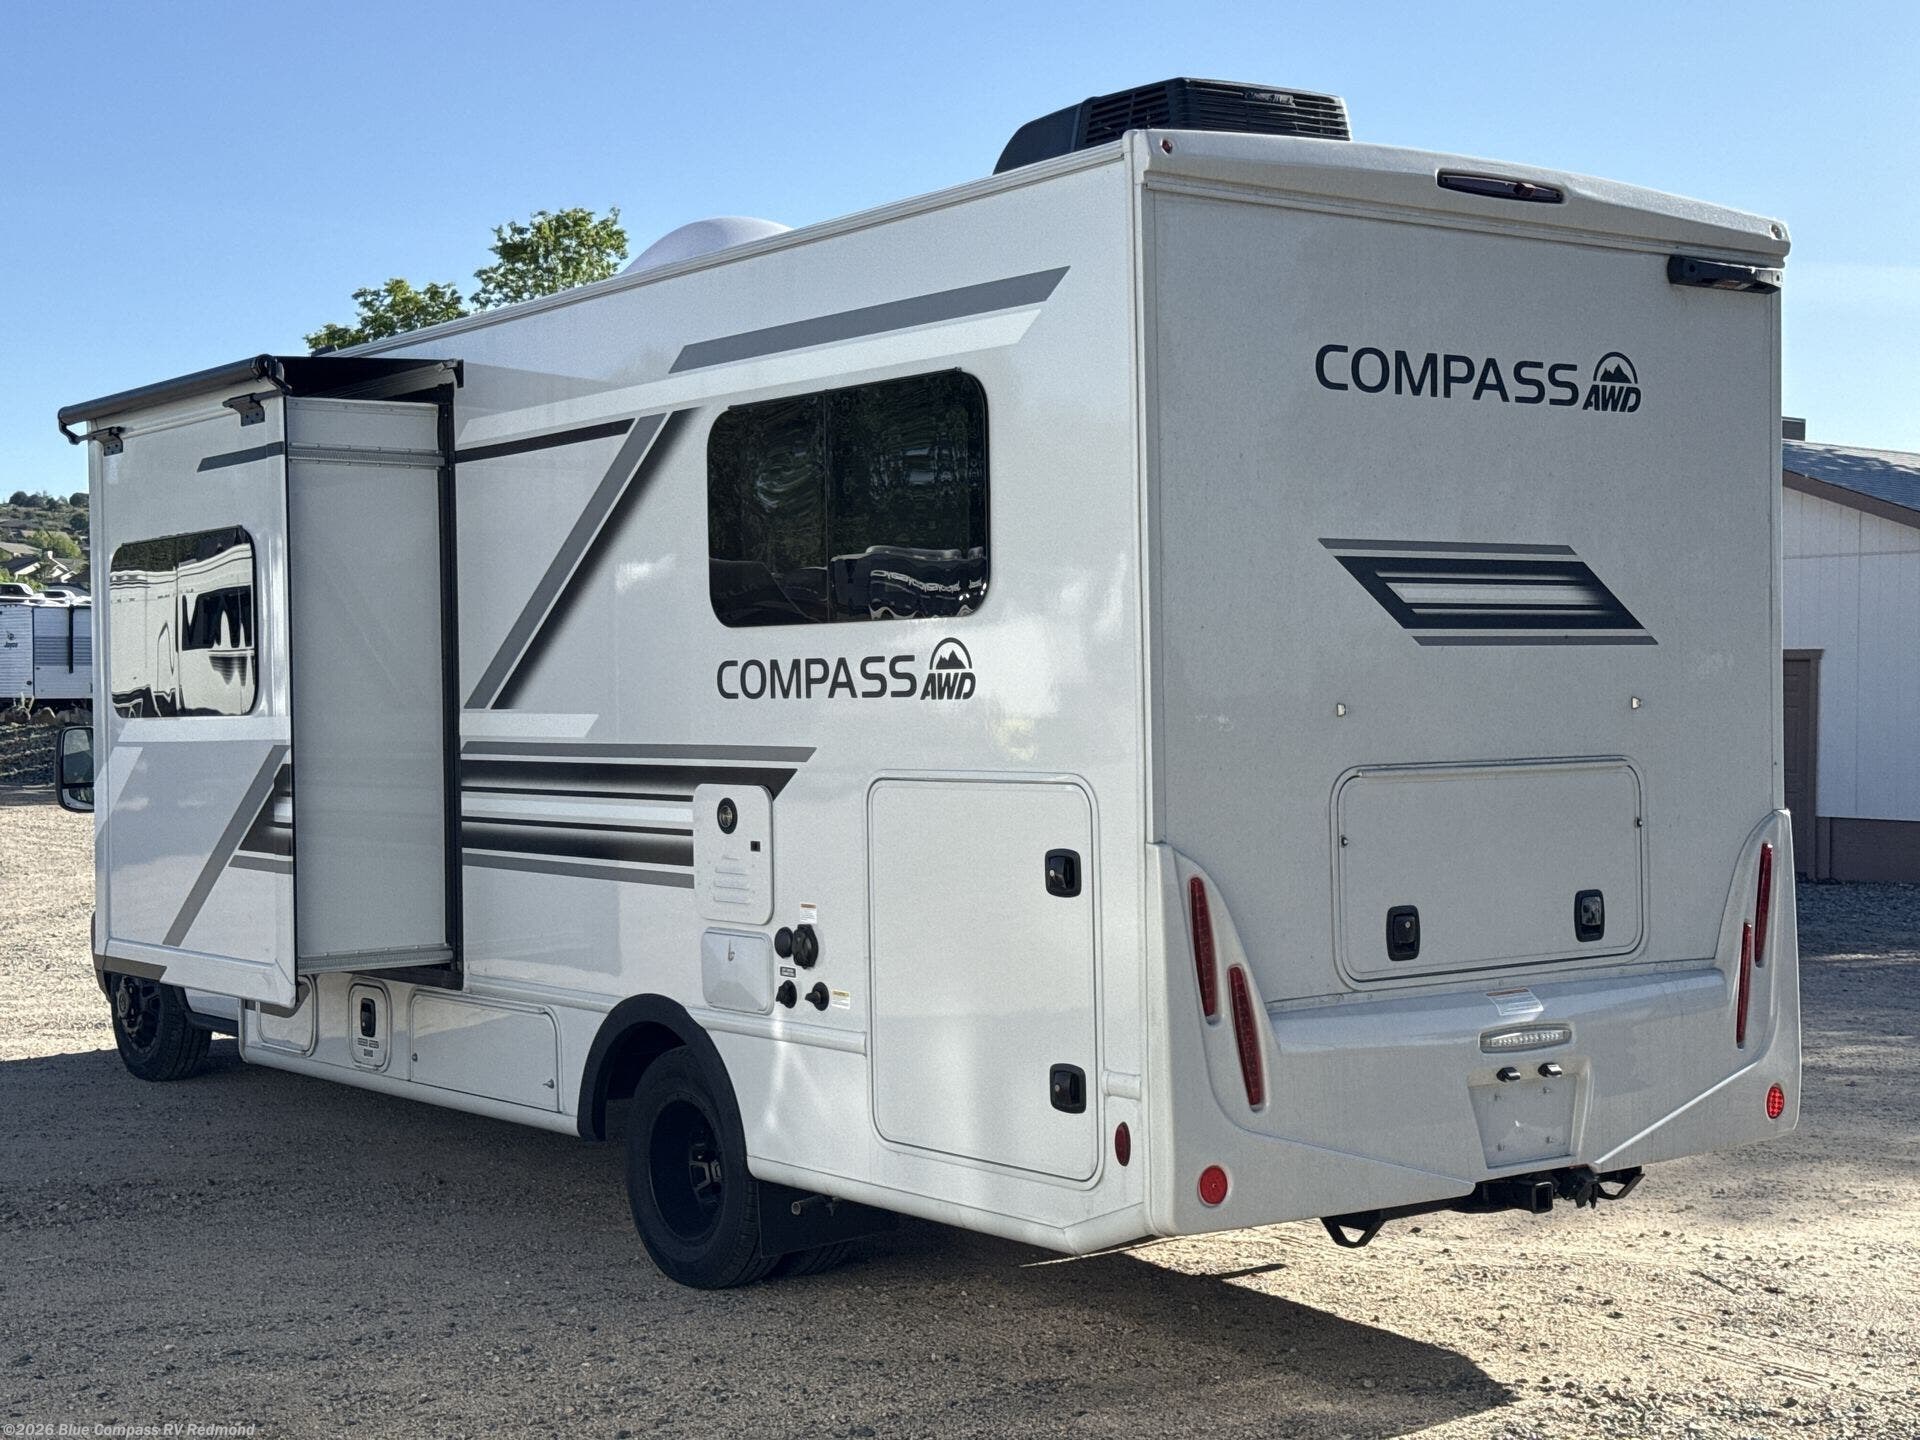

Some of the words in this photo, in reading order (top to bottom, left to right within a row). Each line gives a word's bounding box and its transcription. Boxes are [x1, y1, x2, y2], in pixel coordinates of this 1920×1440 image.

[1315, 344, 1579, 406] COMPASS
[1582, 384, 1642, 413] AWD
[717, 654, 917, 700] COMPASS
[920, 672, 976, 700] AWD
